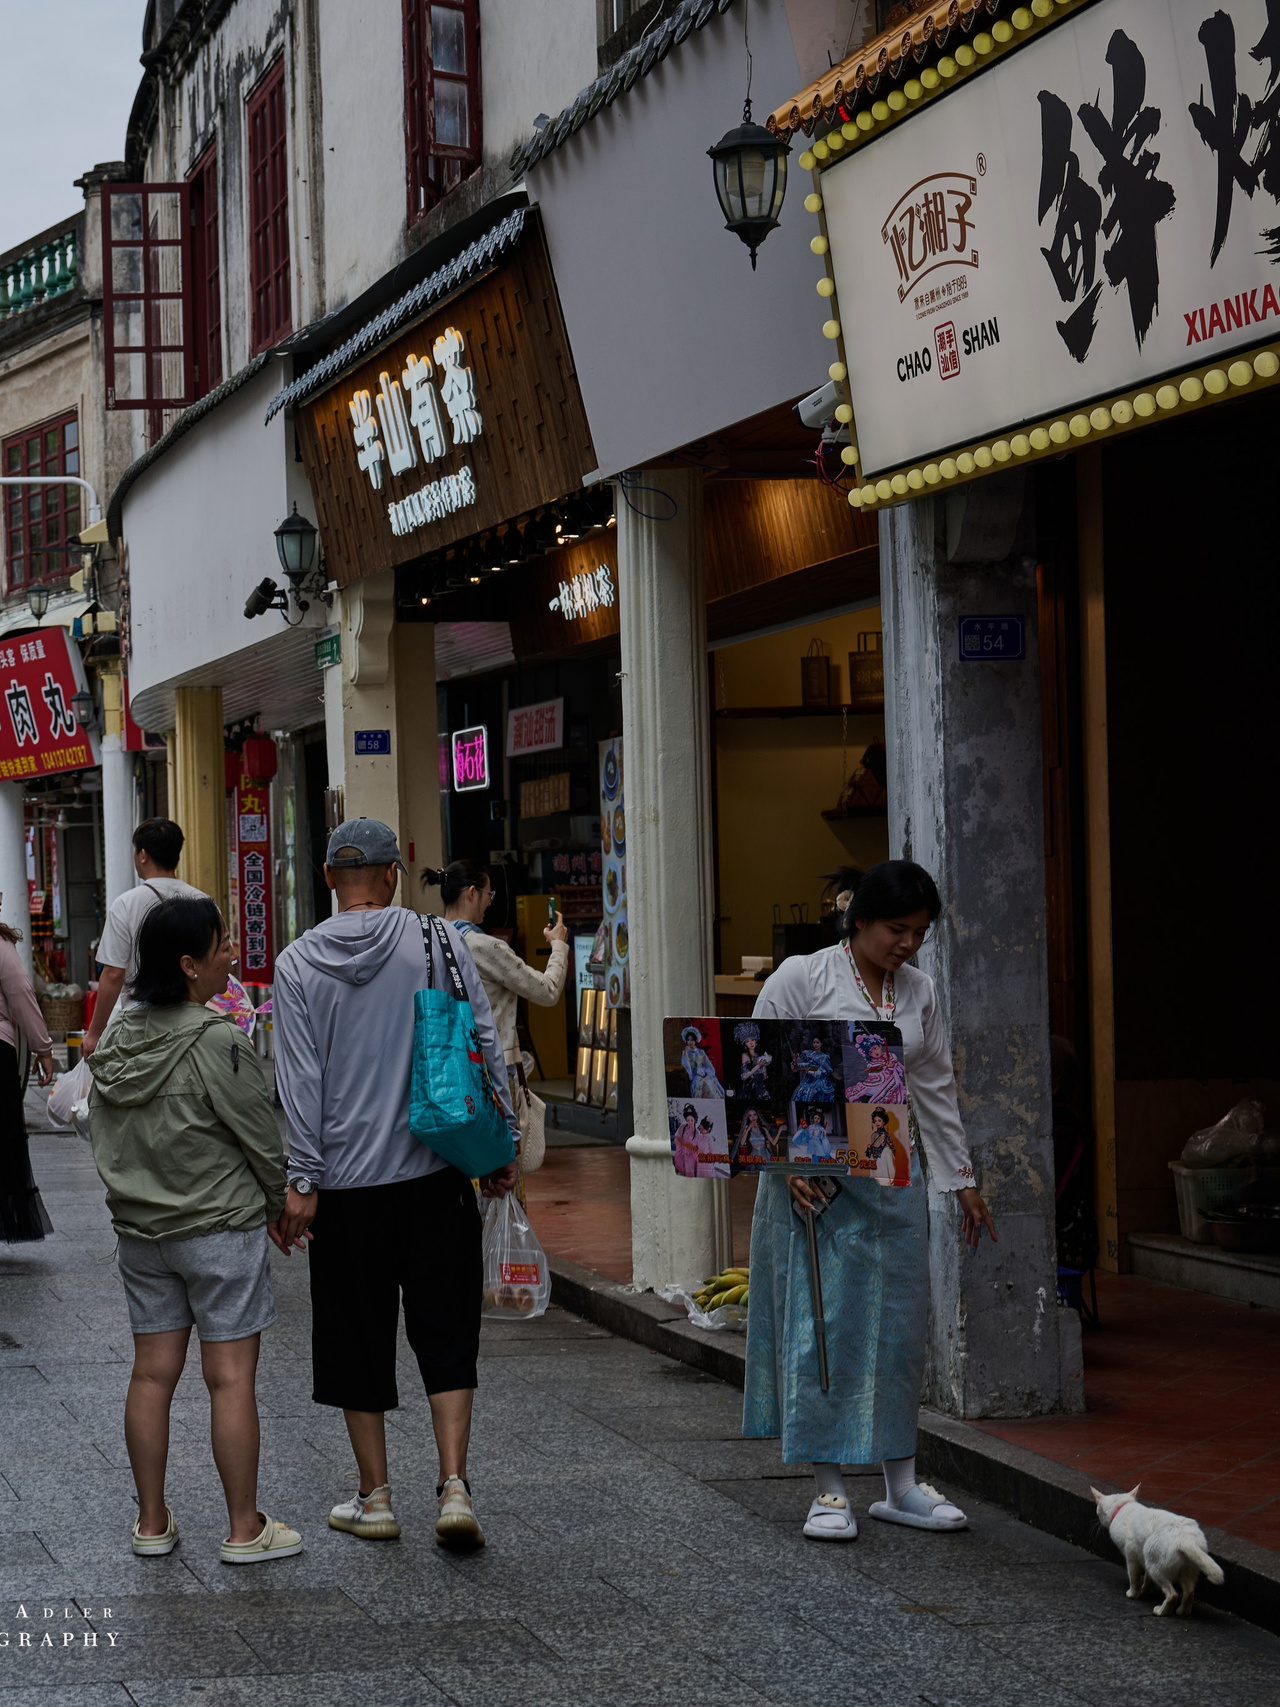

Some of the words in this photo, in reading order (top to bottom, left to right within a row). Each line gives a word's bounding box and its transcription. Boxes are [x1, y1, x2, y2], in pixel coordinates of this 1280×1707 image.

[889, 189, 976, 283] 忆湘子
[1183, 283, 1280, 346] XIANKA
[897, 347, 932, 382] CHAO
[962, 316, 1001, 356] SHAN
[20, 639, 47, 664] 保质量
[982, 634, 1005, 651] 54
[367, 739, 380, 750] 58
[243, 850, 268, 971] 全国冷链寄到家
